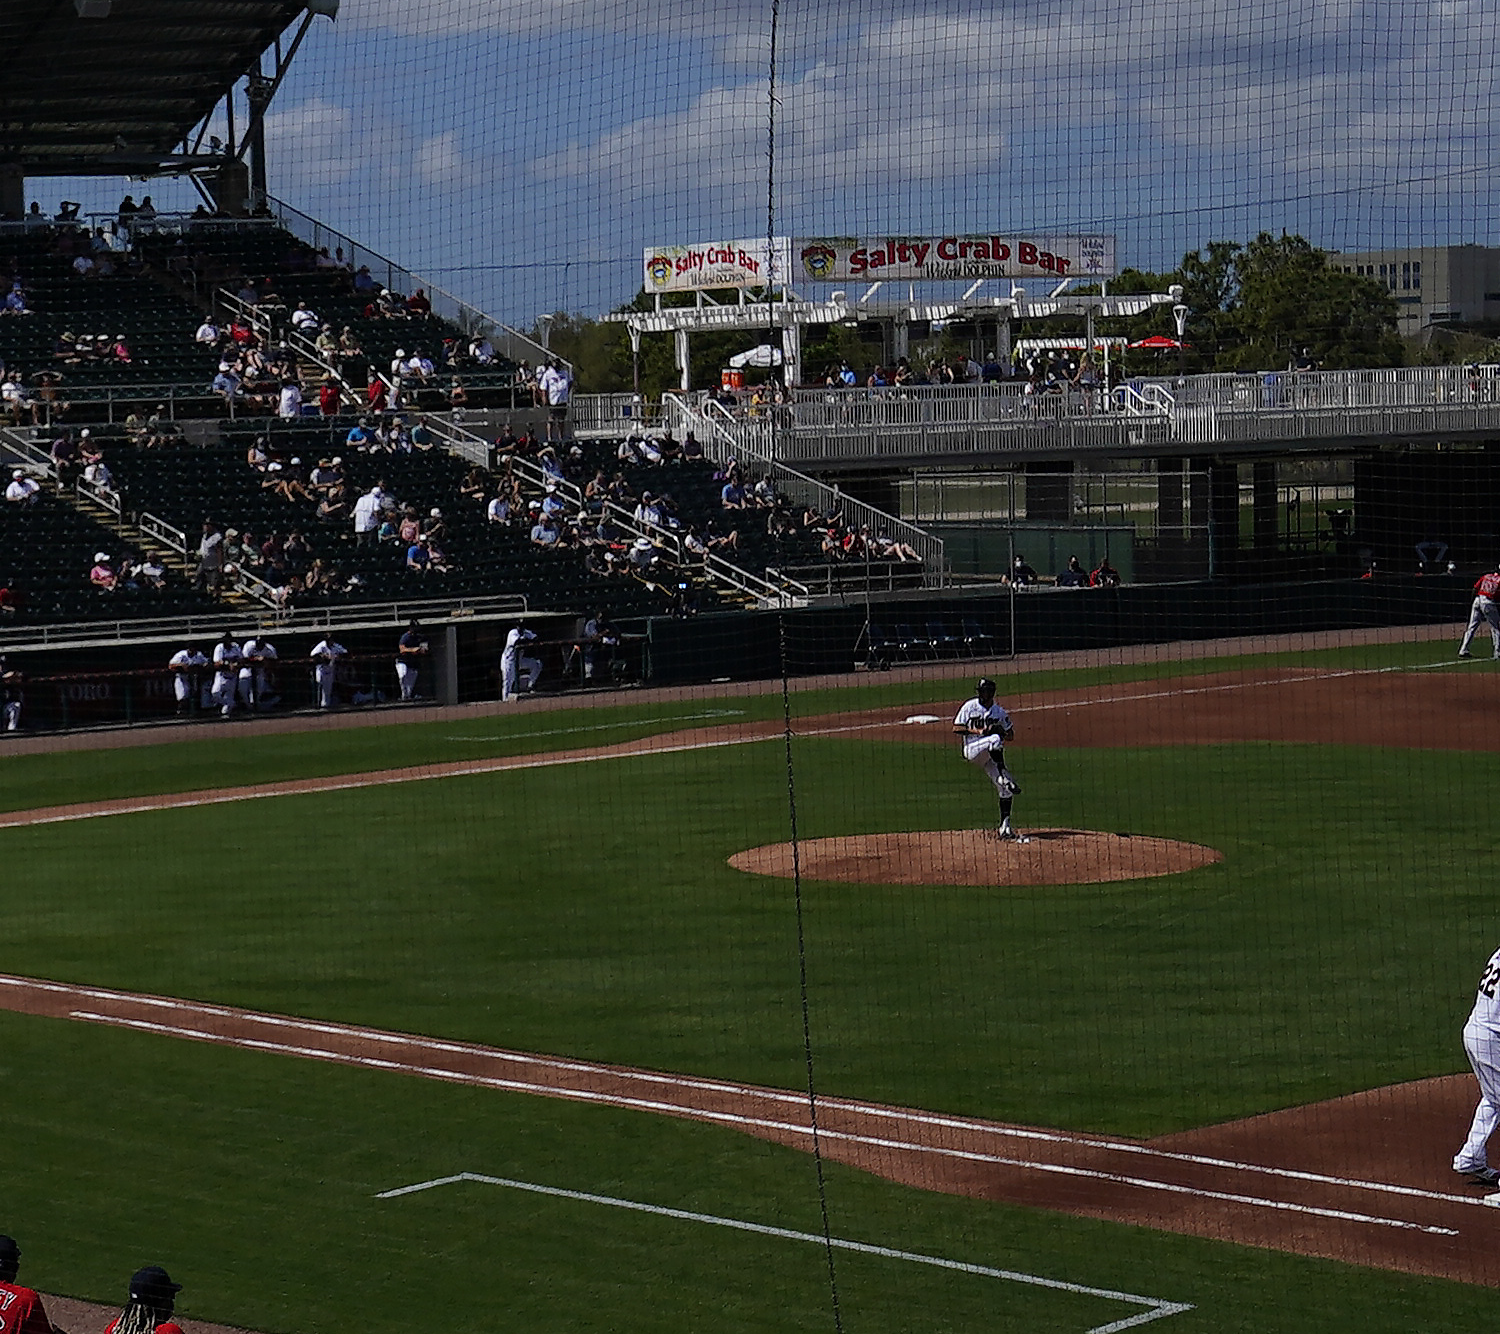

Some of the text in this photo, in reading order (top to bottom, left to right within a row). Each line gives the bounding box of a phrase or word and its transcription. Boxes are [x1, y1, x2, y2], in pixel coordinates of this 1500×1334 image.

[676, 245, 761, 276] Salty Crab Bar
[849, 240, 931, 274] Salty
[937, 236, 1010, 262] Crab
[1017, 241, 1071, 275] Bar
